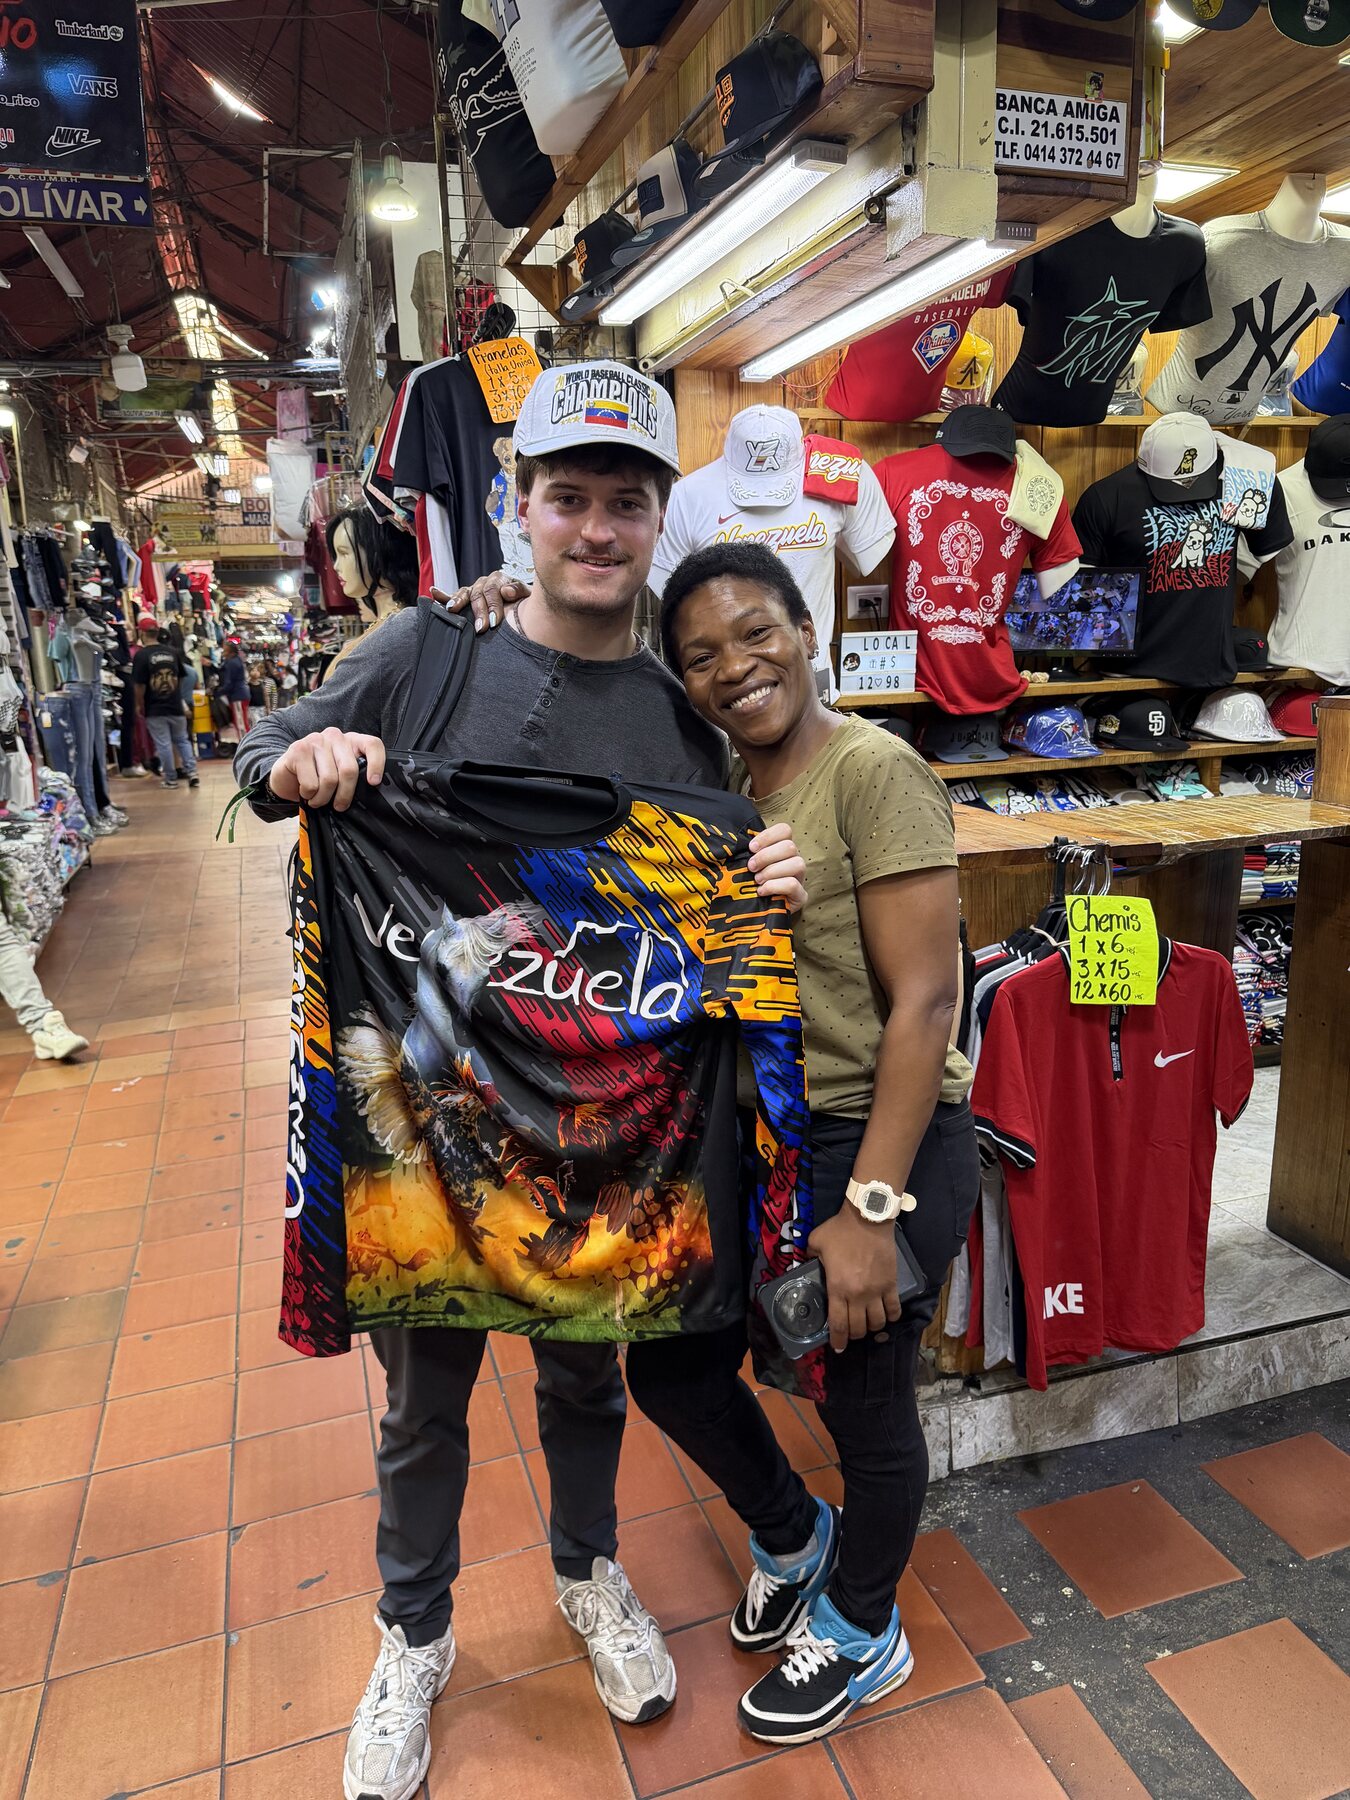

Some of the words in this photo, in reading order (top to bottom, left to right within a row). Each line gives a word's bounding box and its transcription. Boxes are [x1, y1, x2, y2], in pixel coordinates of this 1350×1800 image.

[55, 20, 111, 40] Timberland
[67, 73, 118, 98] VANS
[996, 93, 1058, 116] BANCA
[1063, 101, 1120, 123] AMIGA
[54, 126, 89, 145] NIKE
[998, 117, 1025, 136] C.I.
[1031, 120, 1117, 146] 21.615.501
[995, 141, 1020, 160] TLF.
[1024, 144, 1056, 163] 0414
[1060, 147, 1083, 166] 372
[1087, 150, 1102, 168] 44
[1106, 152, 1121, 169] 67
[565, 369, 590, 386] WORLD
[591, 369, 625, 383] BASEBALL
[551, 379, 658, 440] CHAMPIONS
[1177, 394, 1214, 417] New
[1148, 711, 1165, 736] SD
[1069, 896, 1141, 932] Chemis
[1079, 935, 1086, 953] 1
[1111, 933, 1124, 953] 6
[1077, 959, 1090, 979] 3
[1110, 959, 1130, 980] 15
[1075, 981, 1094, 1000] 12
[1109, 983, 1131, 1002] 60
